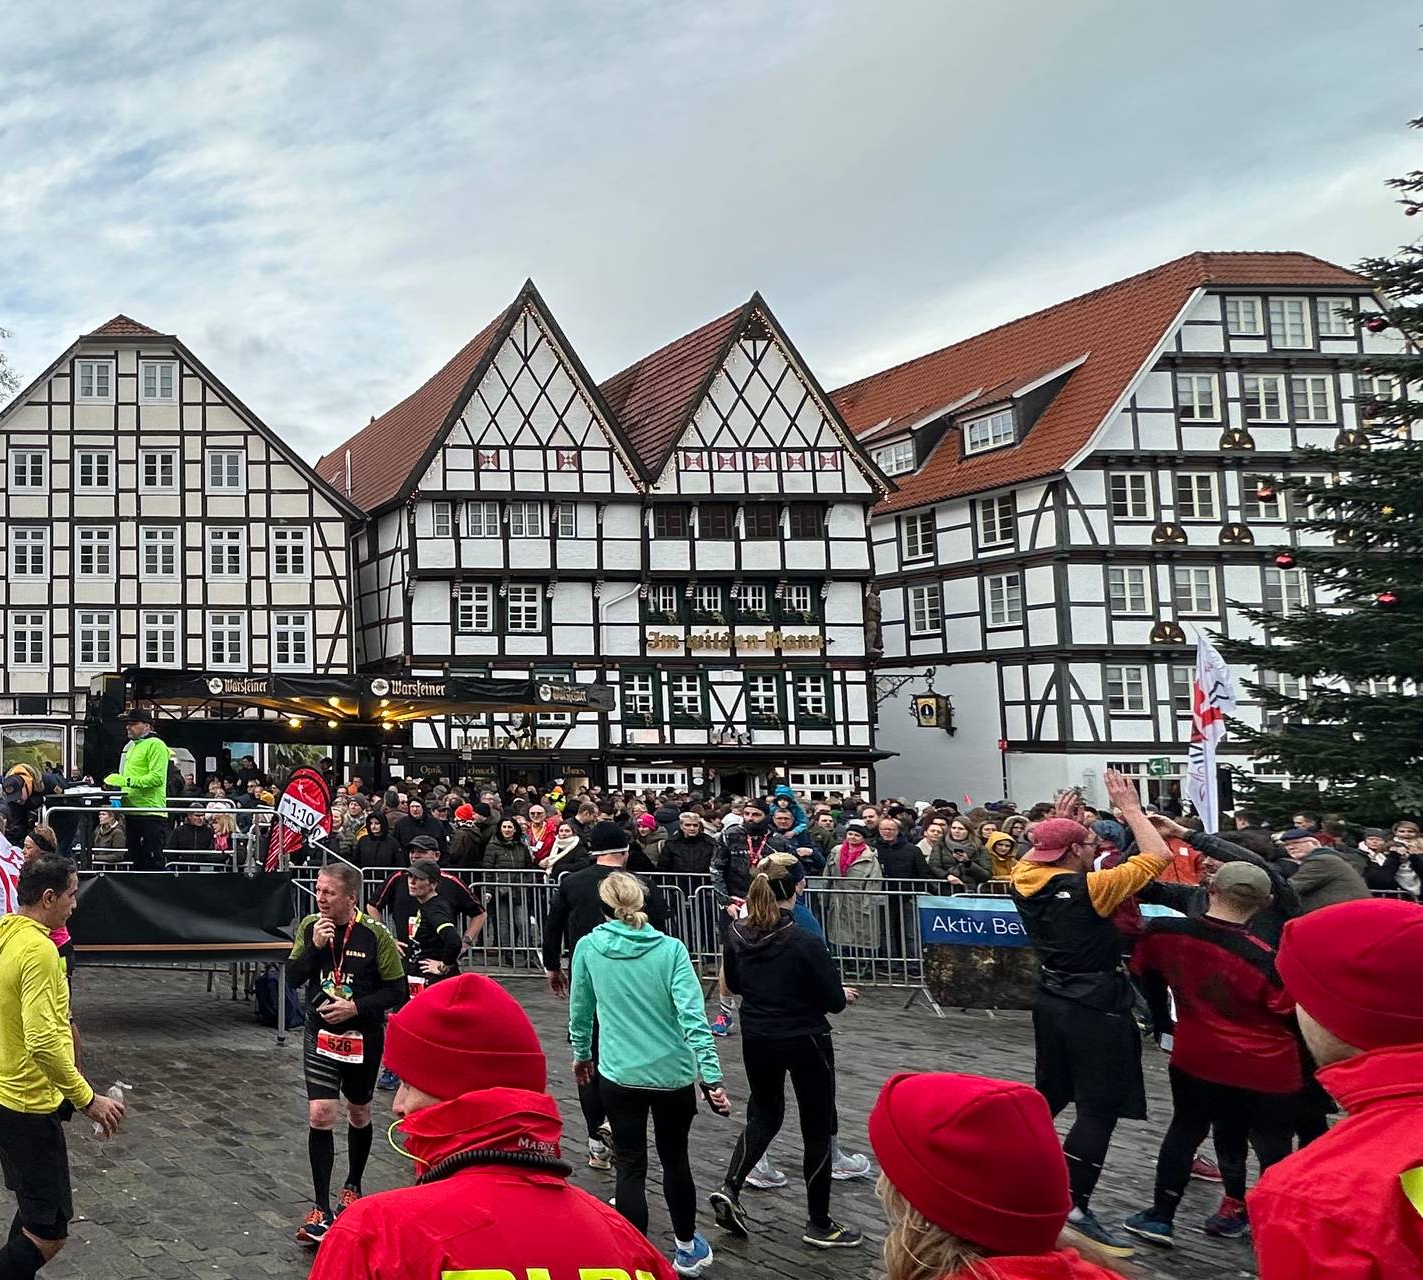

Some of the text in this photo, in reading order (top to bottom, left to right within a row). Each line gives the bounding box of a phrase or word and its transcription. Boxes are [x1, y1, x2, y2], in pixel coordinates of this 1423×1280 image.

[647, 629, 824, 649] Im wilden Mann
[224, 678, 267, 693] Warsteiner
[391, 678, 445, 696] Warsteiner
[290, 802, 315, 826] 1:10
[932, 915, 1027, 935] Aktiv. Be
[327, 1036, 352, 1053] 526
